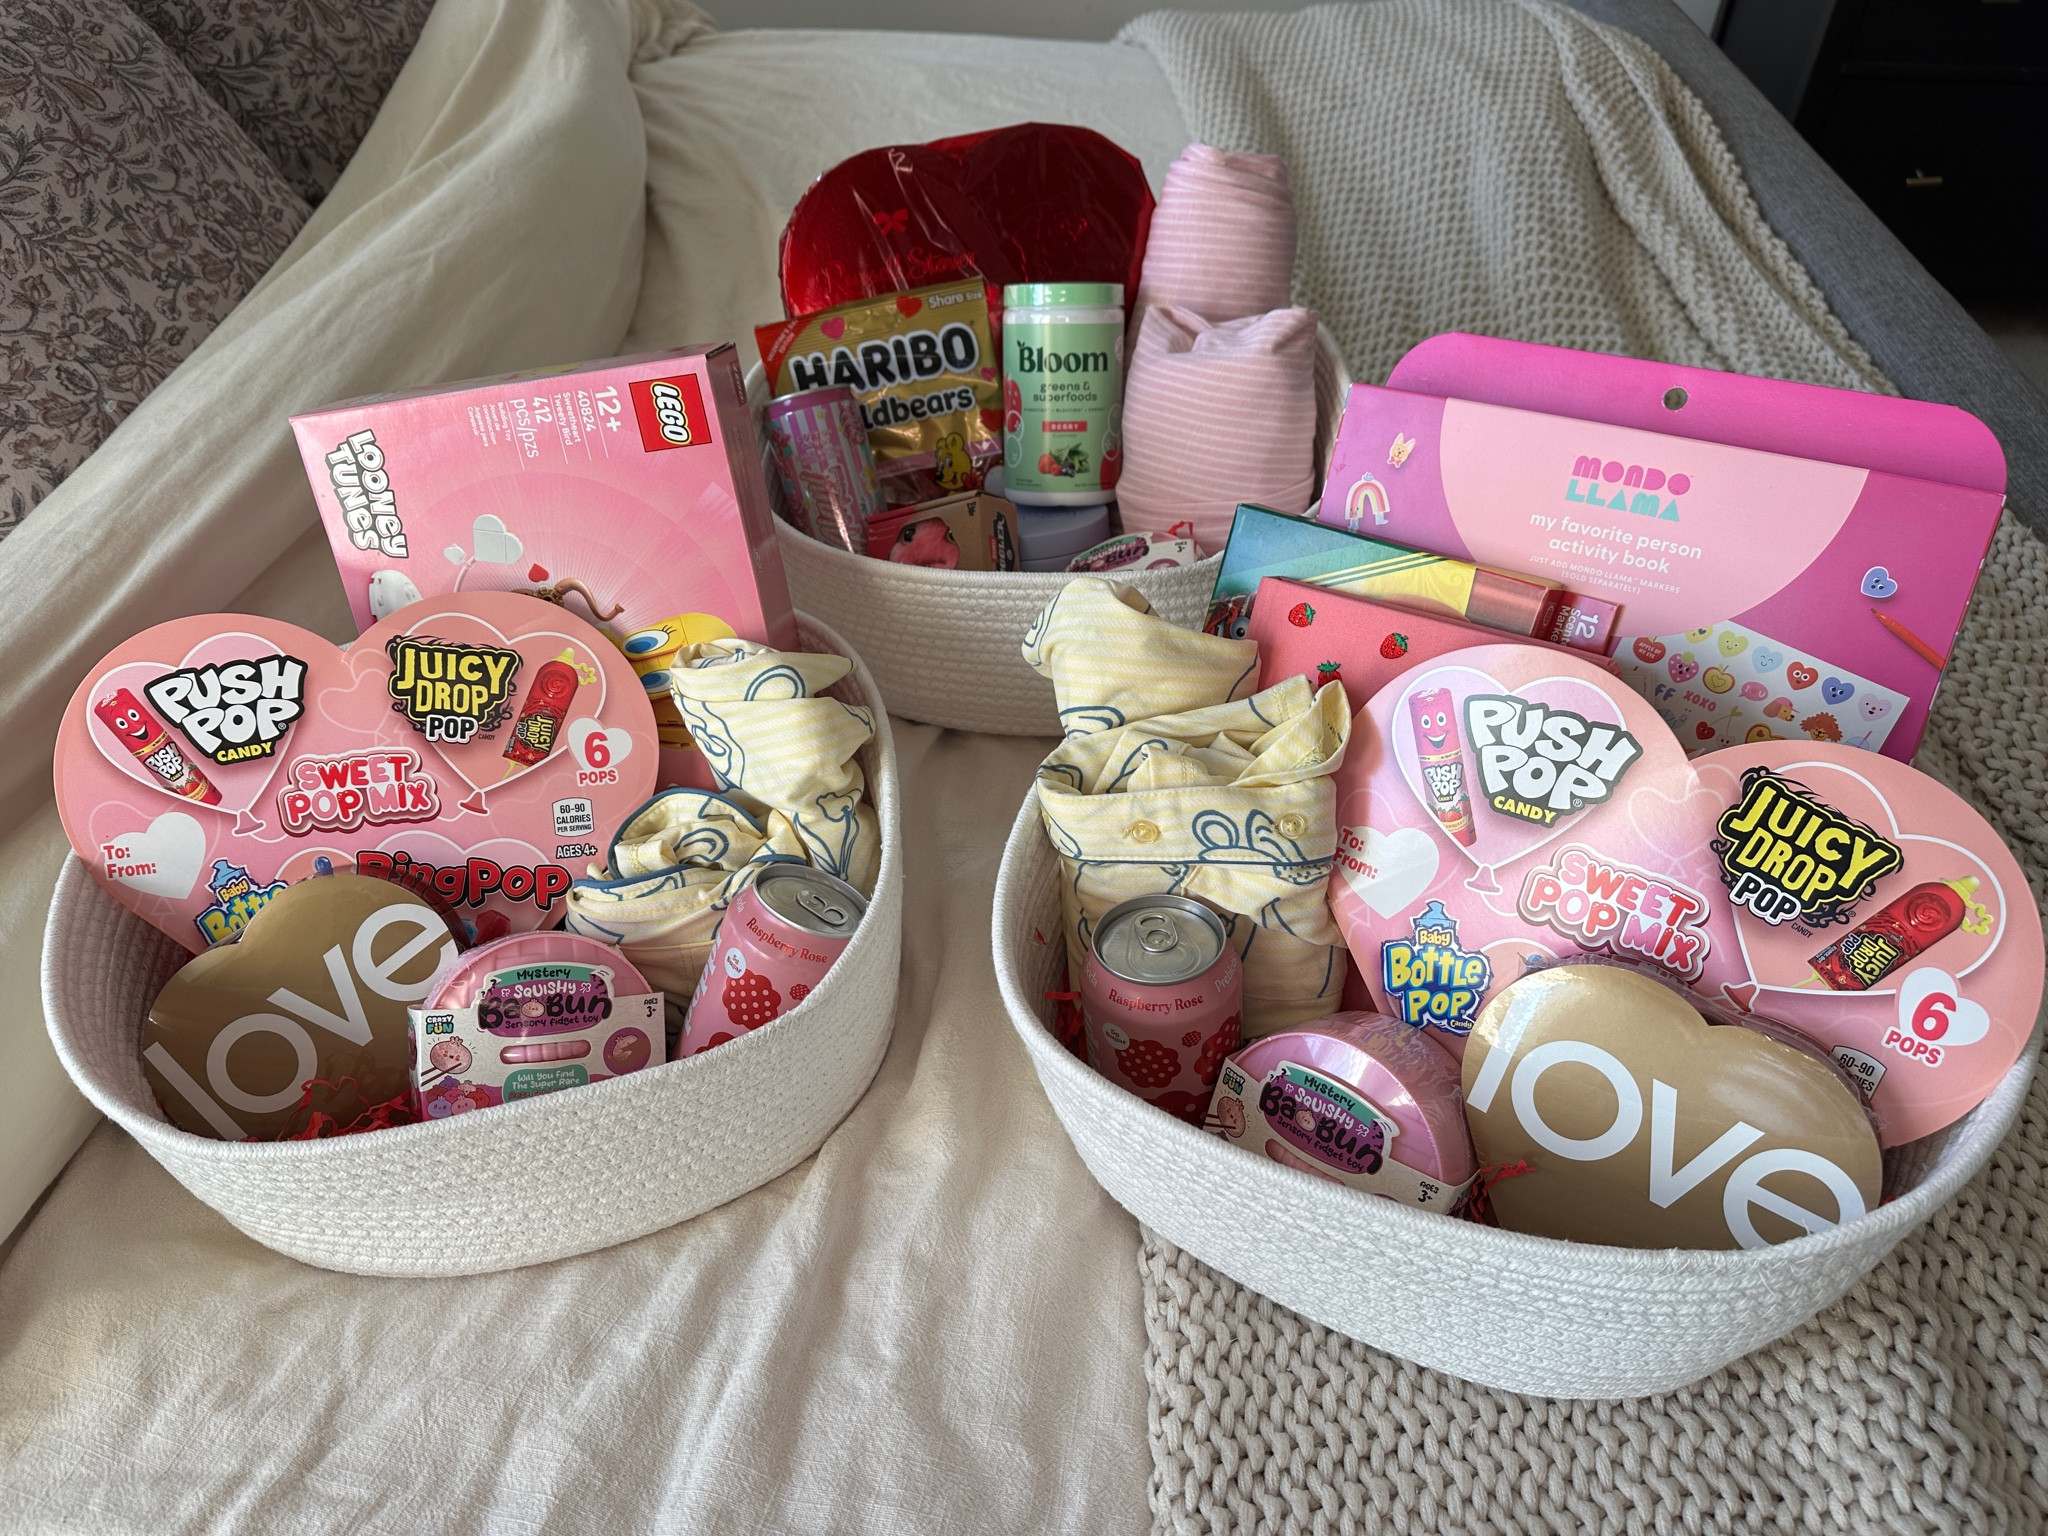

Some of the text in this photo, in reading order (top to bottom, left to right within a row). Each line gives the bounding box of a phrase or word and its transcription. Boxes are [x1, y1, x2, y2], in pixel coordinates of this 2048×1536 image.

[928, 293, 964, 309] Share
[793, 327, 976, 390] HARIBO
[1018, 342, 1109, 373] Bloom
[1033, 391, 1098, 402] superfoods
[1040, 382, 1081, 392] greens
[532, 396, 552, 424] 412
[553, 394, 573, 446] Tweety Bird
[562, 392, 581, 443] Sweetheart
[577, 390, 597, 432] 40824
[595, 386, 622, 433] 12+
[651, 382, 691, 445] LEGO
[510, 399, 539, 459] pcs/pzs
[1051, 423, 1080, 431] BERRY
[1572, 455, 1691, 496] MONDO
[1565, 478, 1680, 522] LLAMA
[1529, 513, 1702, 559] my favorite person
[1549, 538, 1671, 574] activity book
[1529, 555, 1549, 565] JUST
[1550, 559, 1568, 569] ADD
[1569, 563, 1604, 577] MONDO
[1640, 579, 1681, 594] MARKERS
[1561, 571, 1641, 594] (SOLD SEPARATELY)
[1575, 612, 1599, 640] 12
[1638, 641, 1654, 651] APPLE
[397, 647, 512, 695] JUICY
[149, 659, 303, 723] PUSH
[415, 679, 489, 716] DROP
[1682, 689, 1717, 712] XOXO
[181, 698, 300, 754] POP
[428, 716, 475, 740] POP
[478, 733, 496, 741] CANDY
[517, 722, 526, 739] POP
[527, 719, 540, 749] DROP
[535, 715, 555, 752] JUICY
[216, 742, 272, 762] CANDY
[584, 731, 611, 769] 6
[1469, 700, 1637, 781] PUSH
[145, 742, 181, 771] PUSH
[159, 756, 183, 780] POP
[299, 756, 409, 790] SWEET
[578, 770, 617, 785] POPS
[1425, 763, 1462, 783] PUSH
[1482, 745, 1607, 809] POP
[1431, 778, 1461, 797] POP
[288, 783, 430, 823] POP MIX
[559, 803, 585, 814] 60-90
[1494, 796, 1557, 824] CANDY
[556, 813, 591, 825] CALORIES
[556, 823, 592, 833] PER SERVING
[556, 844, 597, 858] AGES 4+
[1342, 828, 1365, 852] To:
[1730, 785, 1889, 890] JUICY
[103, 845, 131, 859] To:
[1333, 849, 1378, 880] From:
[1736, 828, 1837, 901] DROP
[106, 862, 157, 878] From:
[221, 880, 249, 902] Baby
[1560, 854, 1696, 927] SWEET
[1734, 876, 1797, 920] POP
[1530, 877, 1700, 970] POP MIX
[1791, 922, 1813, 939] CANDY
[745, 917, 829, 964] Raspberry Rose
[1420, 931, 1450, 946] Baby
[1842, 934, 1861, 954] POP
[1850, 936, 1877, 967] DROP
[516, 968, 571, 981] Mystery
[726, 957, 742, 974] Sugar
[1862, 938, 1900, 985] JUICY
[513, 980, 577, 998] SQUISHY
[644, 998, 658, 1006] AGES
[1108, 988, 1204, 1015] Raspberry Rose
[646, 1006, 657, 1018] 3+
[1406, 990, 1471, 1022] POP
[1911, 992, 1957, 1041] 6
[142, 903, 459, 1142] love
[426, 1016, 453, 1025] CRAZY
[426, 1022, 453, 1035] FUN
[505, 1014, 600, 1030] Sensory fidget toy
[1450, 1018, 1473, 1029] Candy
[1885, 1030, 1941, 1064] POPS
[518, 1073, 537, 1082] Will
[1225, 1067, 1246, 1085] CRAZY
[1839, 1053, 1875, 1077] 60-90
[512, 1081, 530, 1091] The
[531, 1079, 557, 1092] Super
[559, 1077, 580, 1087] Rare
[1223, 1074, 1244, 1095] FUN
[1304, 1075, 1356, 1110] Mystery
[1295, 1087, 1355, 1130] SQUISHY
[1467, 980, 1867, 1250] love
[1277, 1114, 1365, 1173] Sensory fidget toy
[1417, 1189, 1434, 1203] 3+
[1419, 1180, 1440, 1194] AGES
